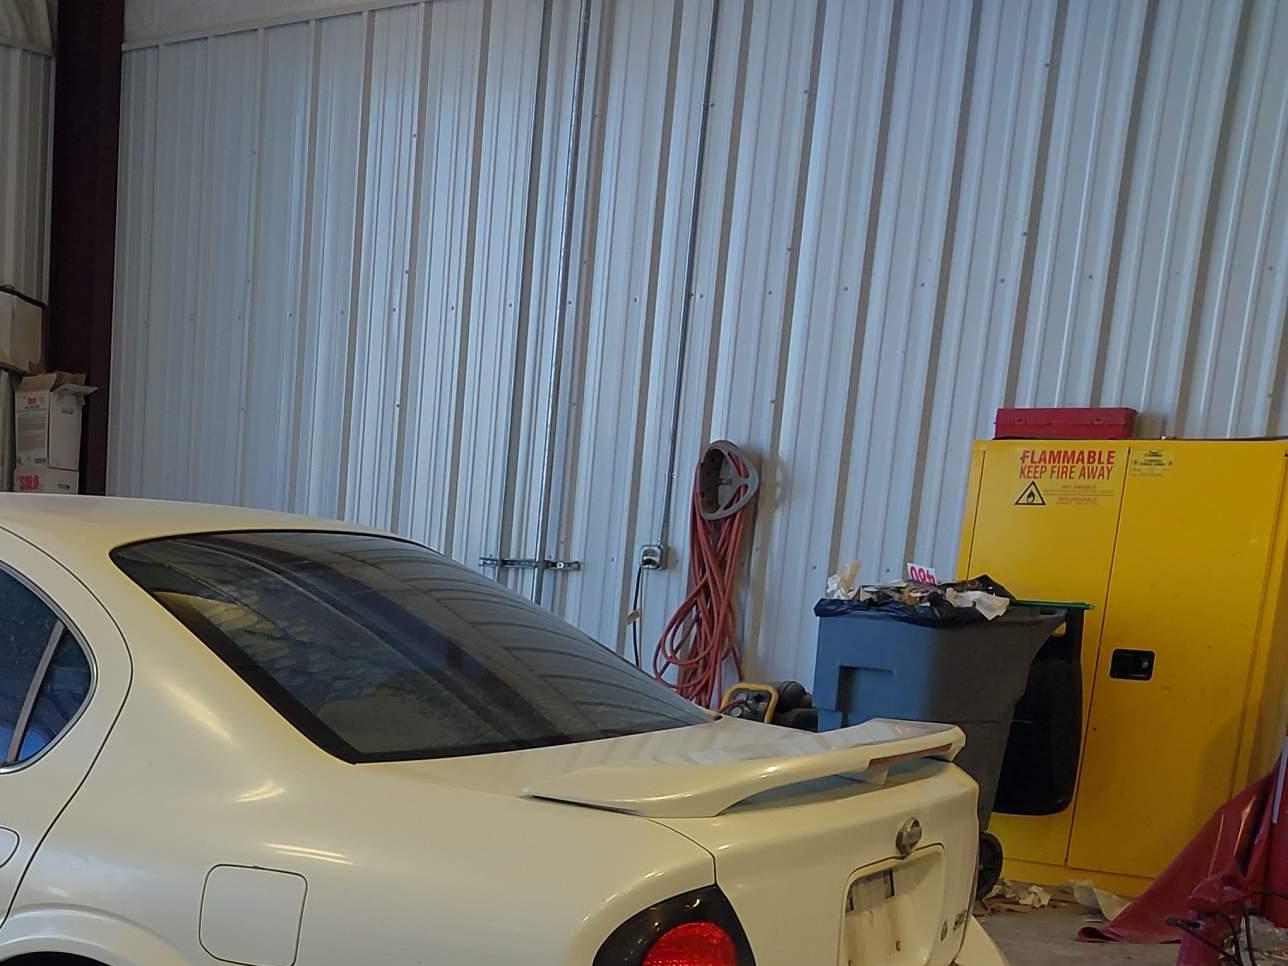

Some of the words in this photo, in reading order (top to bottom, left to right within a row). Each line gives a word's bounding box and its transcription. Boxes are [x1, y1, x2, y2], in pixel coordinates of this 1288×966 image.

[1020, 450, 1116, 465] FLAMMABLE
[1019, 465, 1047, 480] KEEP
[1049, 465, 1076, 480] FIRE
[1078, 466, 1113, 481] AWAY
